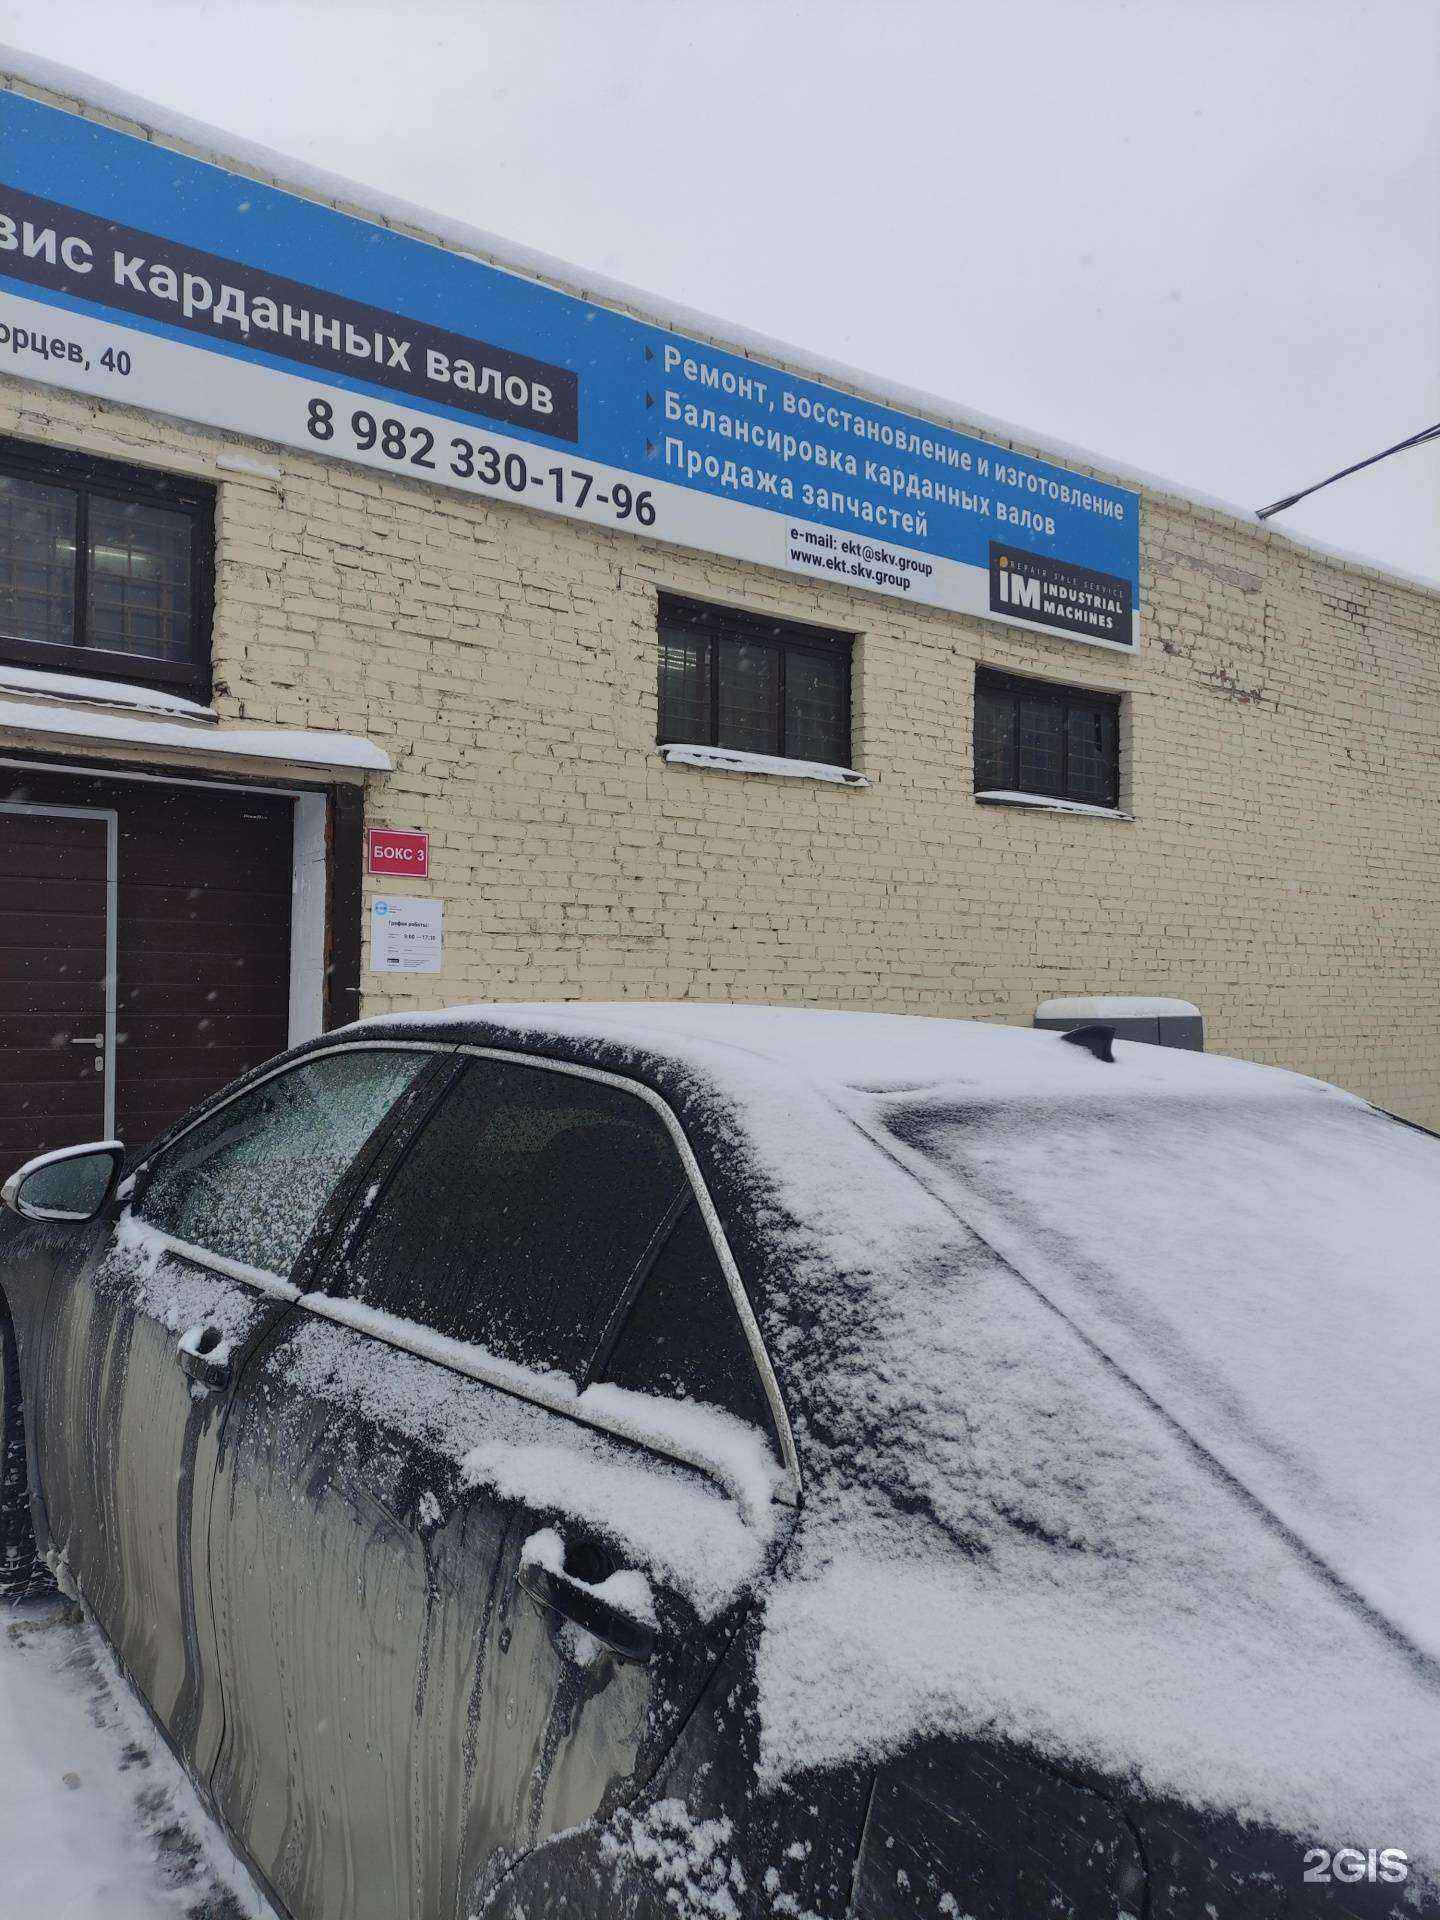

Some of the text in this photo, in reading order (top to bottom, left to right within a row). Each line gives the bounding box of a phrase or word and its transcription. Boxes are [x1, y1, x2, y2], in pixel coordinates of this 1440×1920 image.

[113, 250, 412, 373] карданных
[426, 349, 555, 415] валов
[100, 347, 132, 376] 40
[664, 344, 1125, 521] Ремонт, восстановление и изготовление
[306, 398, 657, 527] 8 982 330-17-96
[664, 389, 1056, 536] Балансировка карданных валов
[665, 436, 929, 538] Продажа запчастей
[790, 526, 933, 578] e-mail: ekt@skv.group
[790, 547, 911, 592] www.ekt.skv.group
[1043, 582, 1123, 614] INDUSTRIAL
[1043, 600, 1114, 629] MACHINES
[374, 845, 425, 862] БОКС 3
